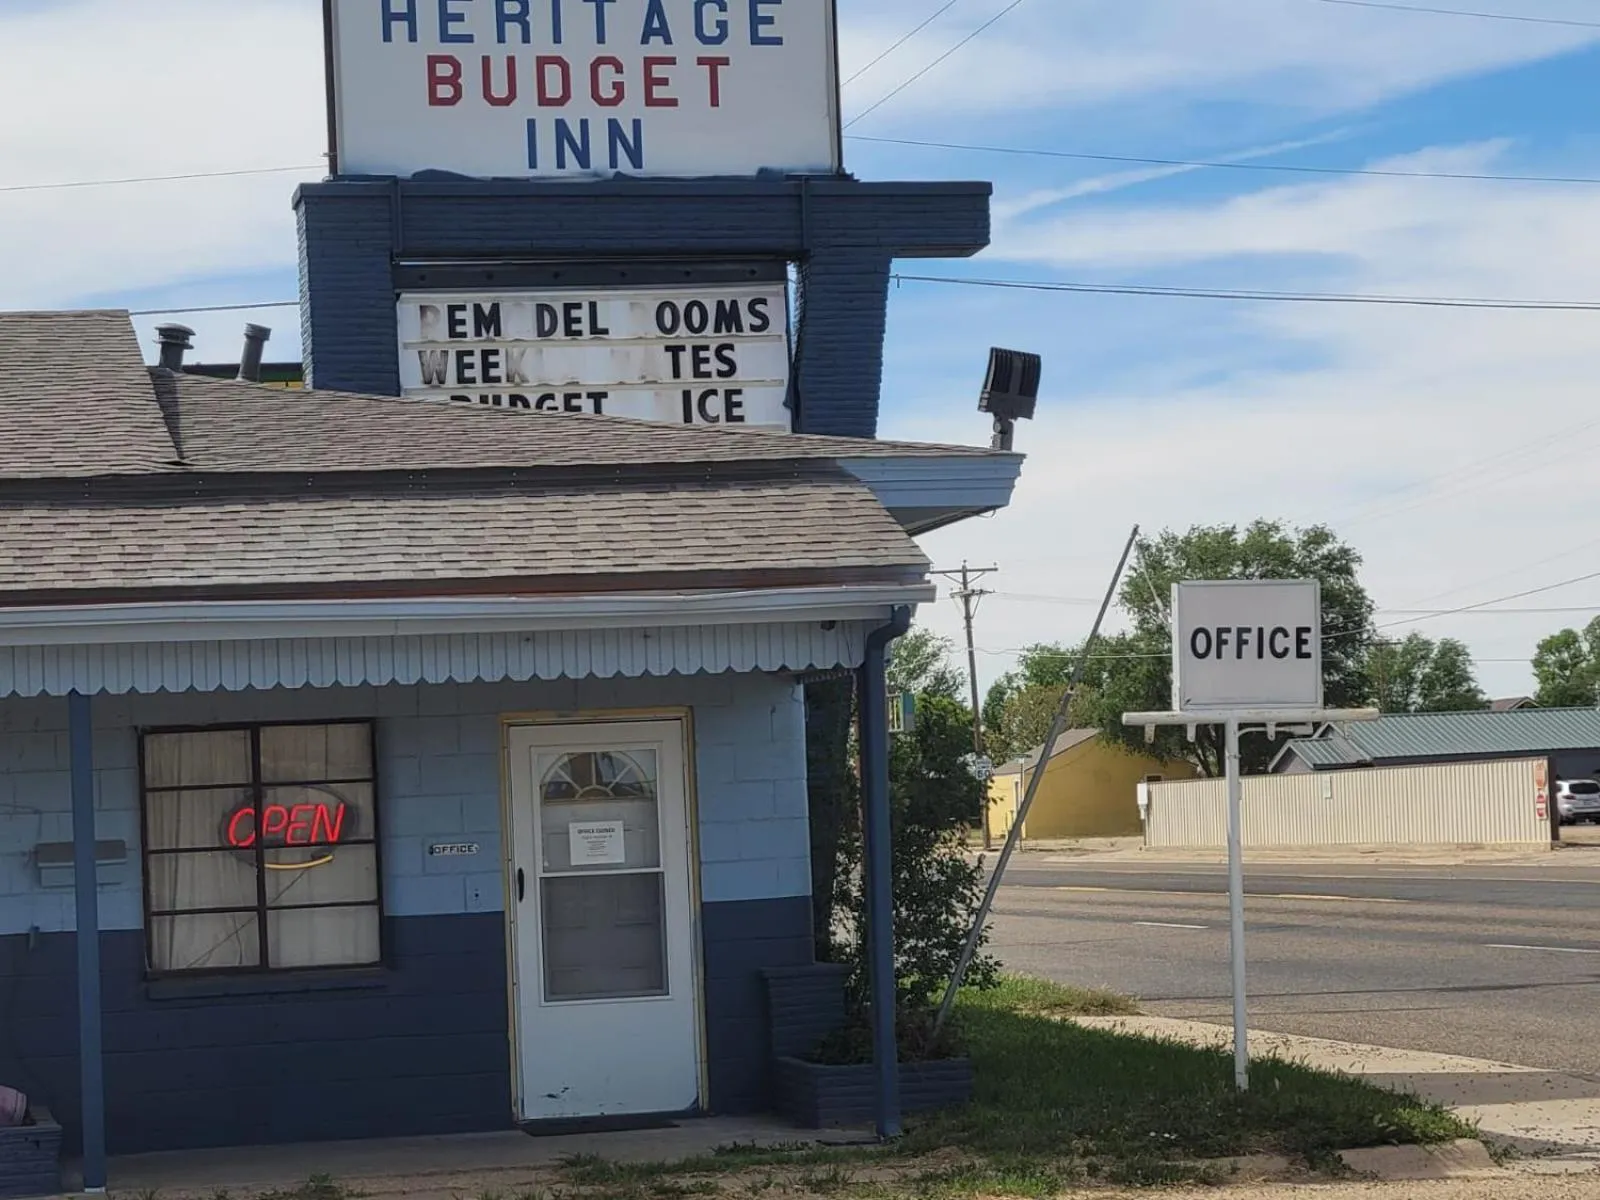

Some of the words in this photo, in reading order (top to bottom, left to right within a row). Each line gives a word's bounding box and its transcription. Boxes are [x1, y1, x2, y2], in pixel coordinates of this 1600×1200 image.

[381, 0, 783, 45] HERITAGE
[427, 55, 730, 107] BUDGET
[527, 118, 644, 169] INN
[536, 301, 609, 338] DEL
[655, 297, 770, 335] OOMS
[664, 343, 737, 379] TES
[682, 388, 745, 424] ICE
[1190, 626, 1312, 660] OFFICE
[228, 803, 345, 847] OPEN
[434, 844, 474, 854] OFFICE
